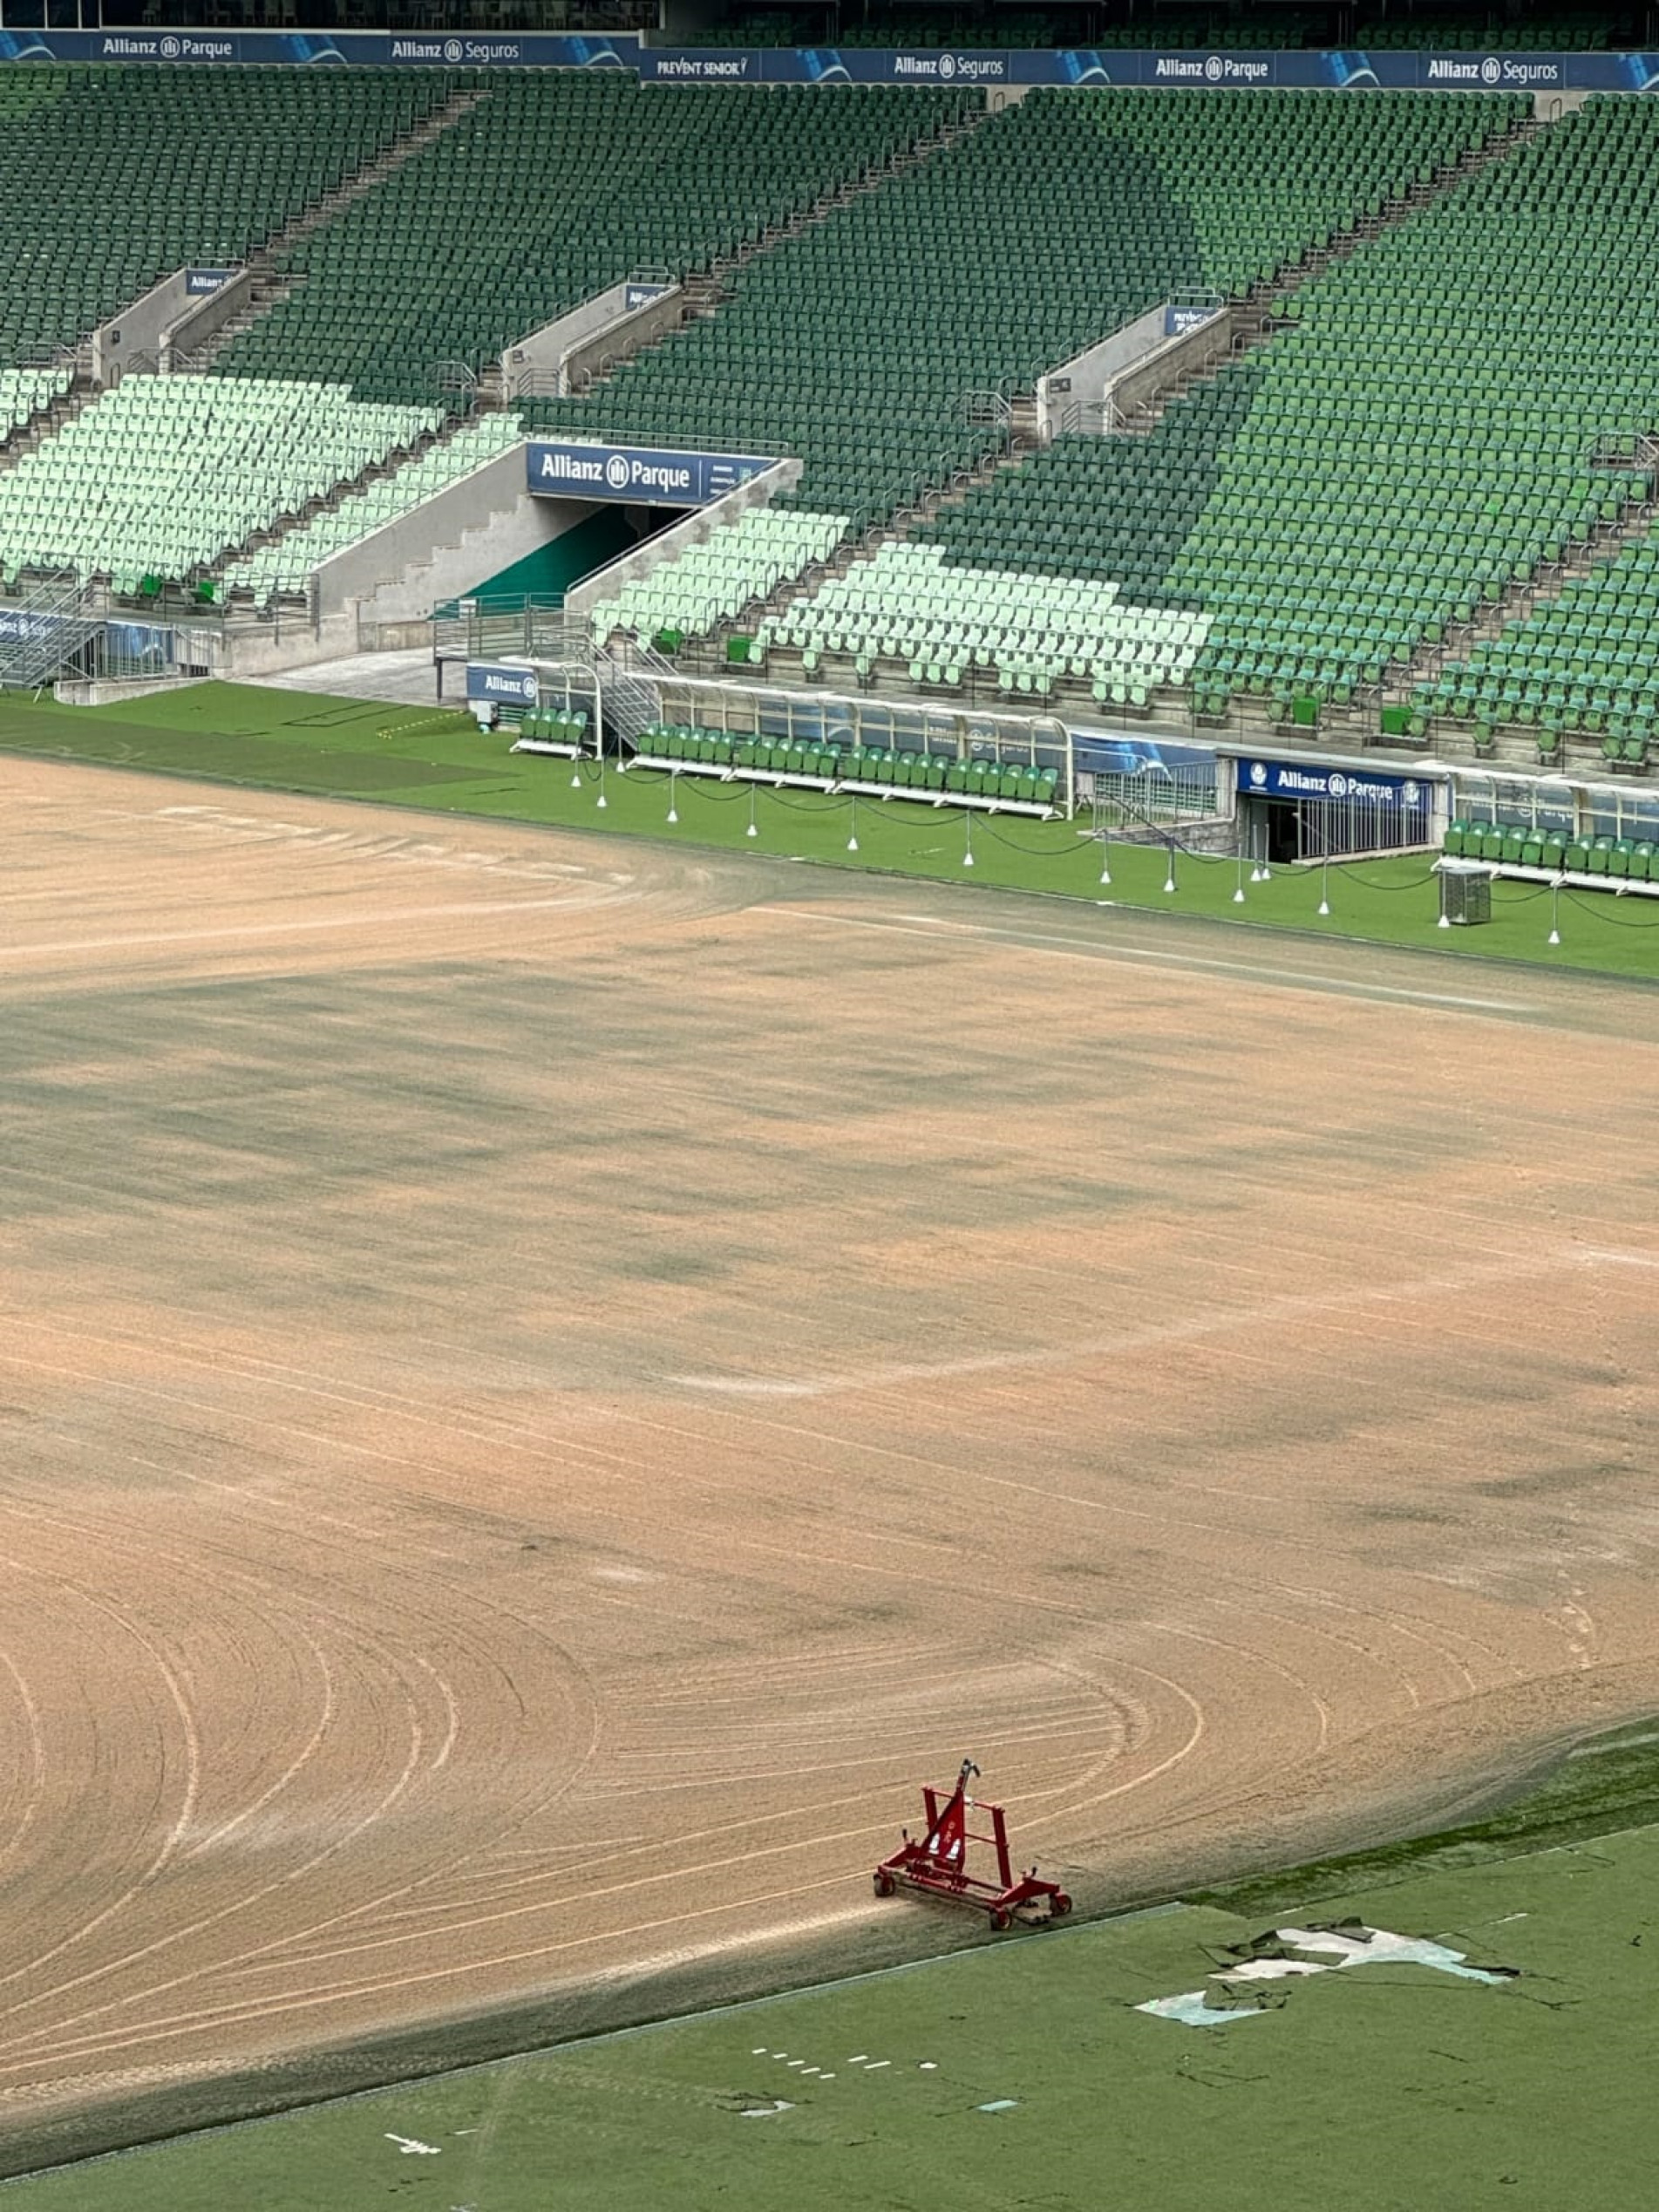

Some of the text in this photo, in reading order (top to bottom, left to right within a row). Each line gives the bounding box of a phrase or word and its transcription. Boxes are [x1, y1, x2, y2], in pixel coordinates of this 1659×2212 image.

[103, 37, 233, 59] Allianz Parque
[392, 41, 520, 63] Allianz Seguros
[657, 57, 741, 76] PREVENT SENIOR
[894, 56, 1003, 80] Allianz Seguros
[1156, 58, 1268, 82] Allianz Parque
[1428, 59, 1558, 85] Allianz Seguros
[541, 453, 690, 493] Allianz Parque
[485, 674, 522, 694] Allianz
[1278, 770, 1393, 802] Allianz Parque
